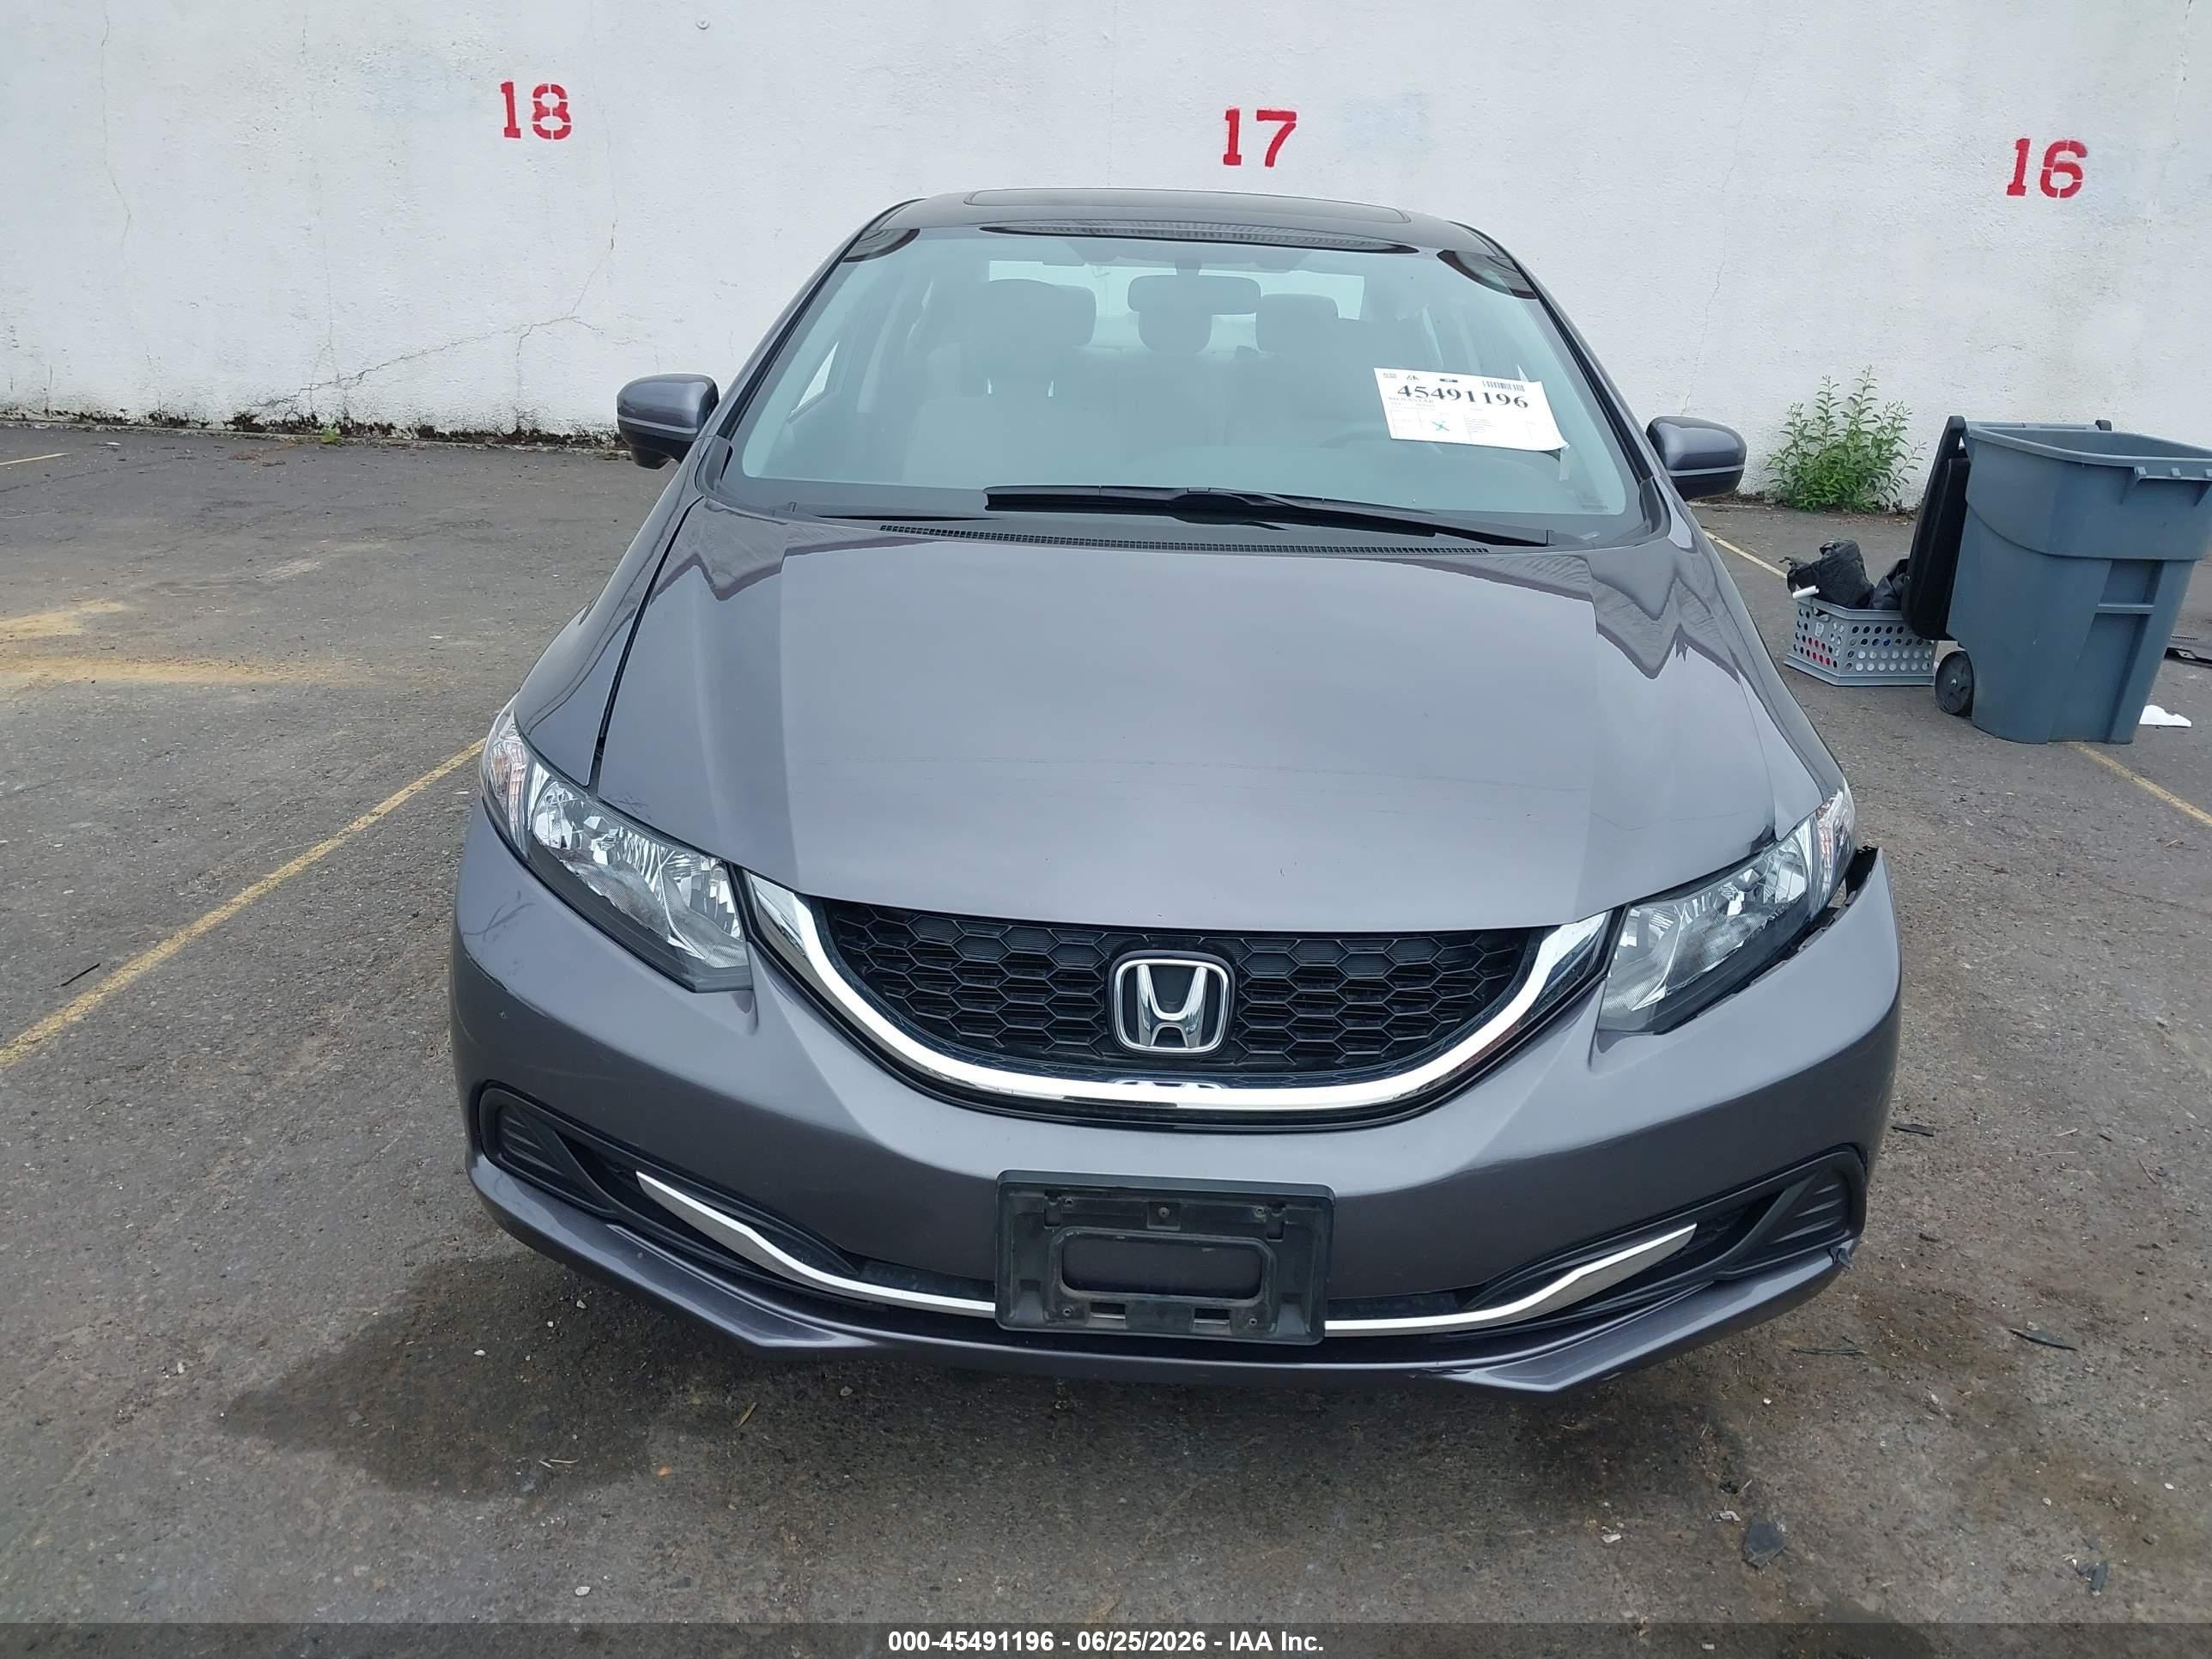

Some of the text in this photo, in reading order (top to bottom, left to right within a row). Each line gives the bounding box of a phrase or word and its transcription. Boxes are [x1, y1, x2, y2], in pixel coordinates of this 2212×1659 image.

[501, 82, 572, 140] 18
[1223, 108, 1297, 167] 17
[2006, 137, 2087, 198] 16
[1397, 384, 1528, 409] 45491196
